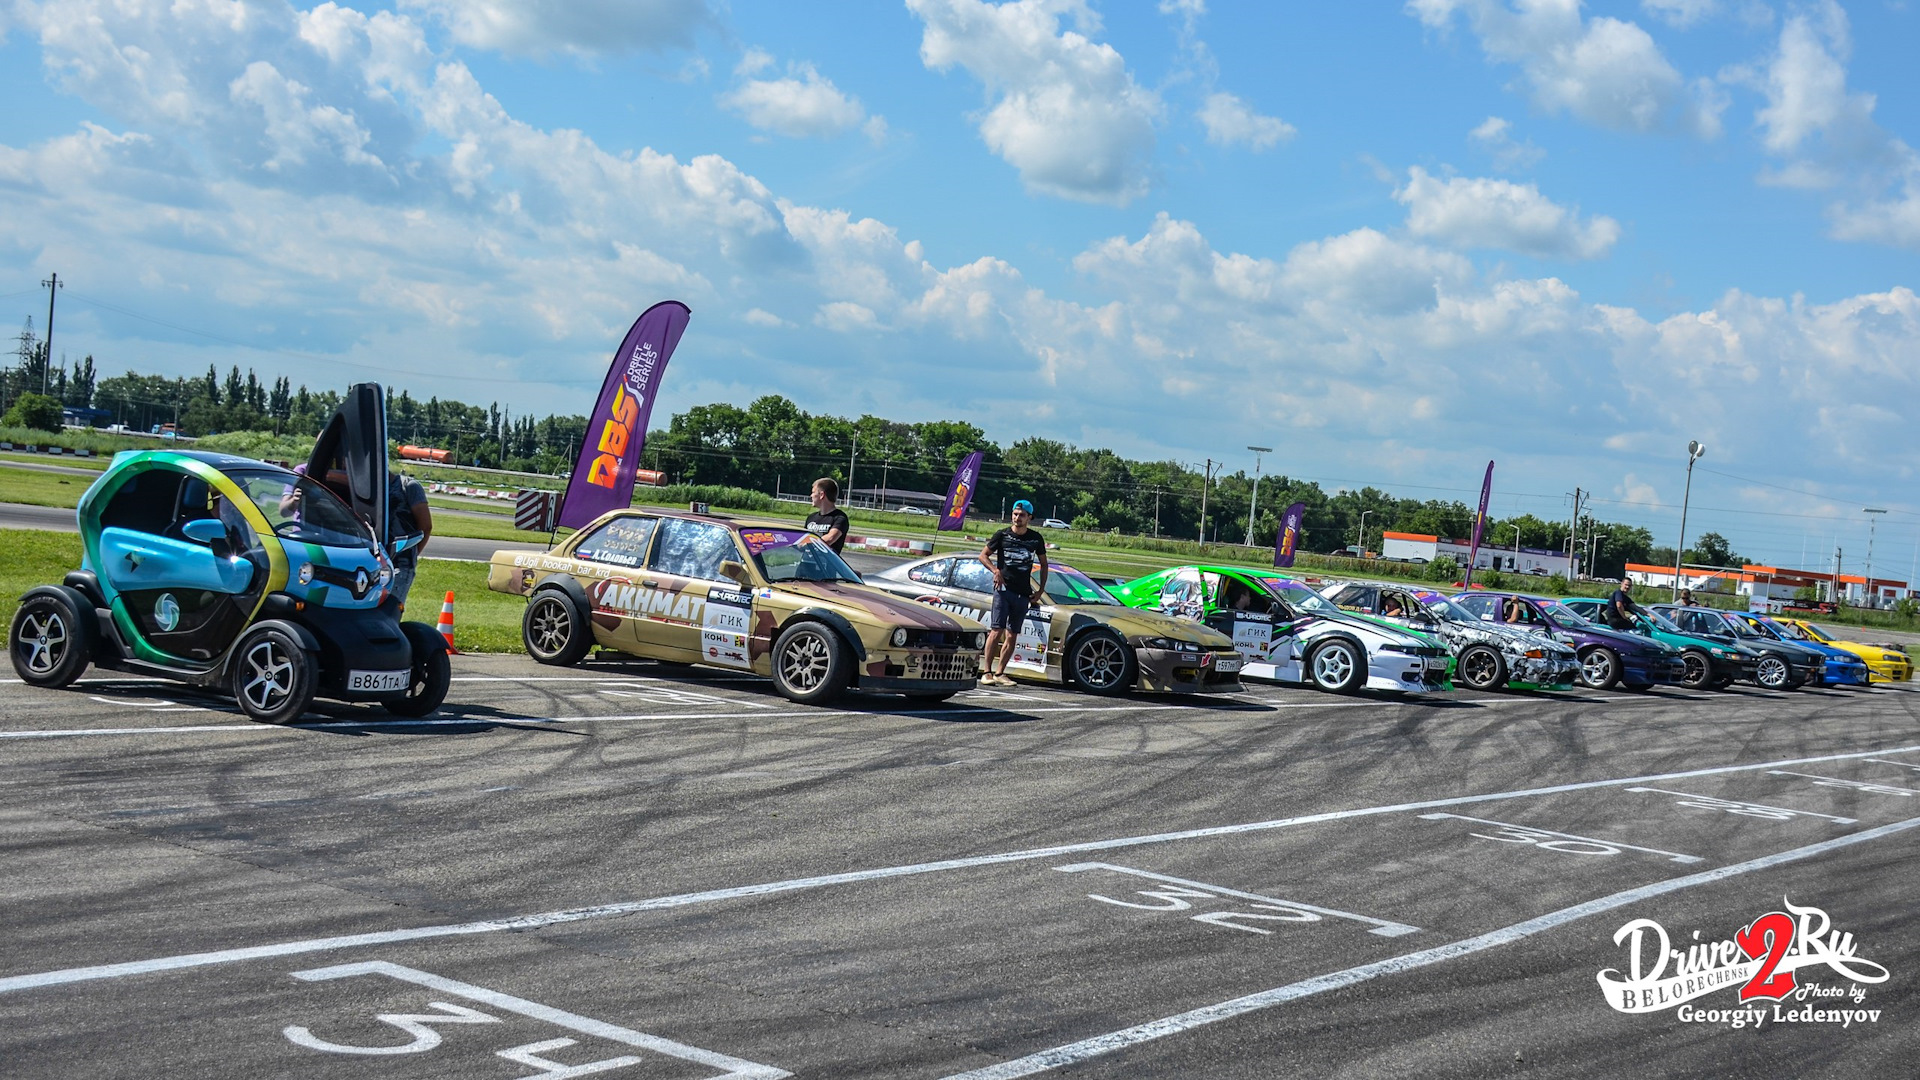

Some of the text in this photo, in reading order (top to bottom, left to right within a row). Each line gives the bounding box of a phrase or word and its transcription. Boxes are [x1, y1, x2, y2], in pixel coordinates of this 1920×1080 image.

[627, 345, 642, 375] DRIFT
[631, 342, 652, 383] BATTLE
[637, 352, 657, 390] SERIES
[587, 383, 638, 489] DBS
[599, 583, 706, 620] AKHMAT
[721, 614, 743, 628] ГИК
[1024, 626, 1044, 638] ГИК
[1248, 628, 1266, 637] ГИК
[704, 633, 728, 643] КОНЬ
[1235, 641, 1255, 649] КОНЬ
[1469, 827, 1618, 855] 30
[1088, 884, 1322, 934] 32
